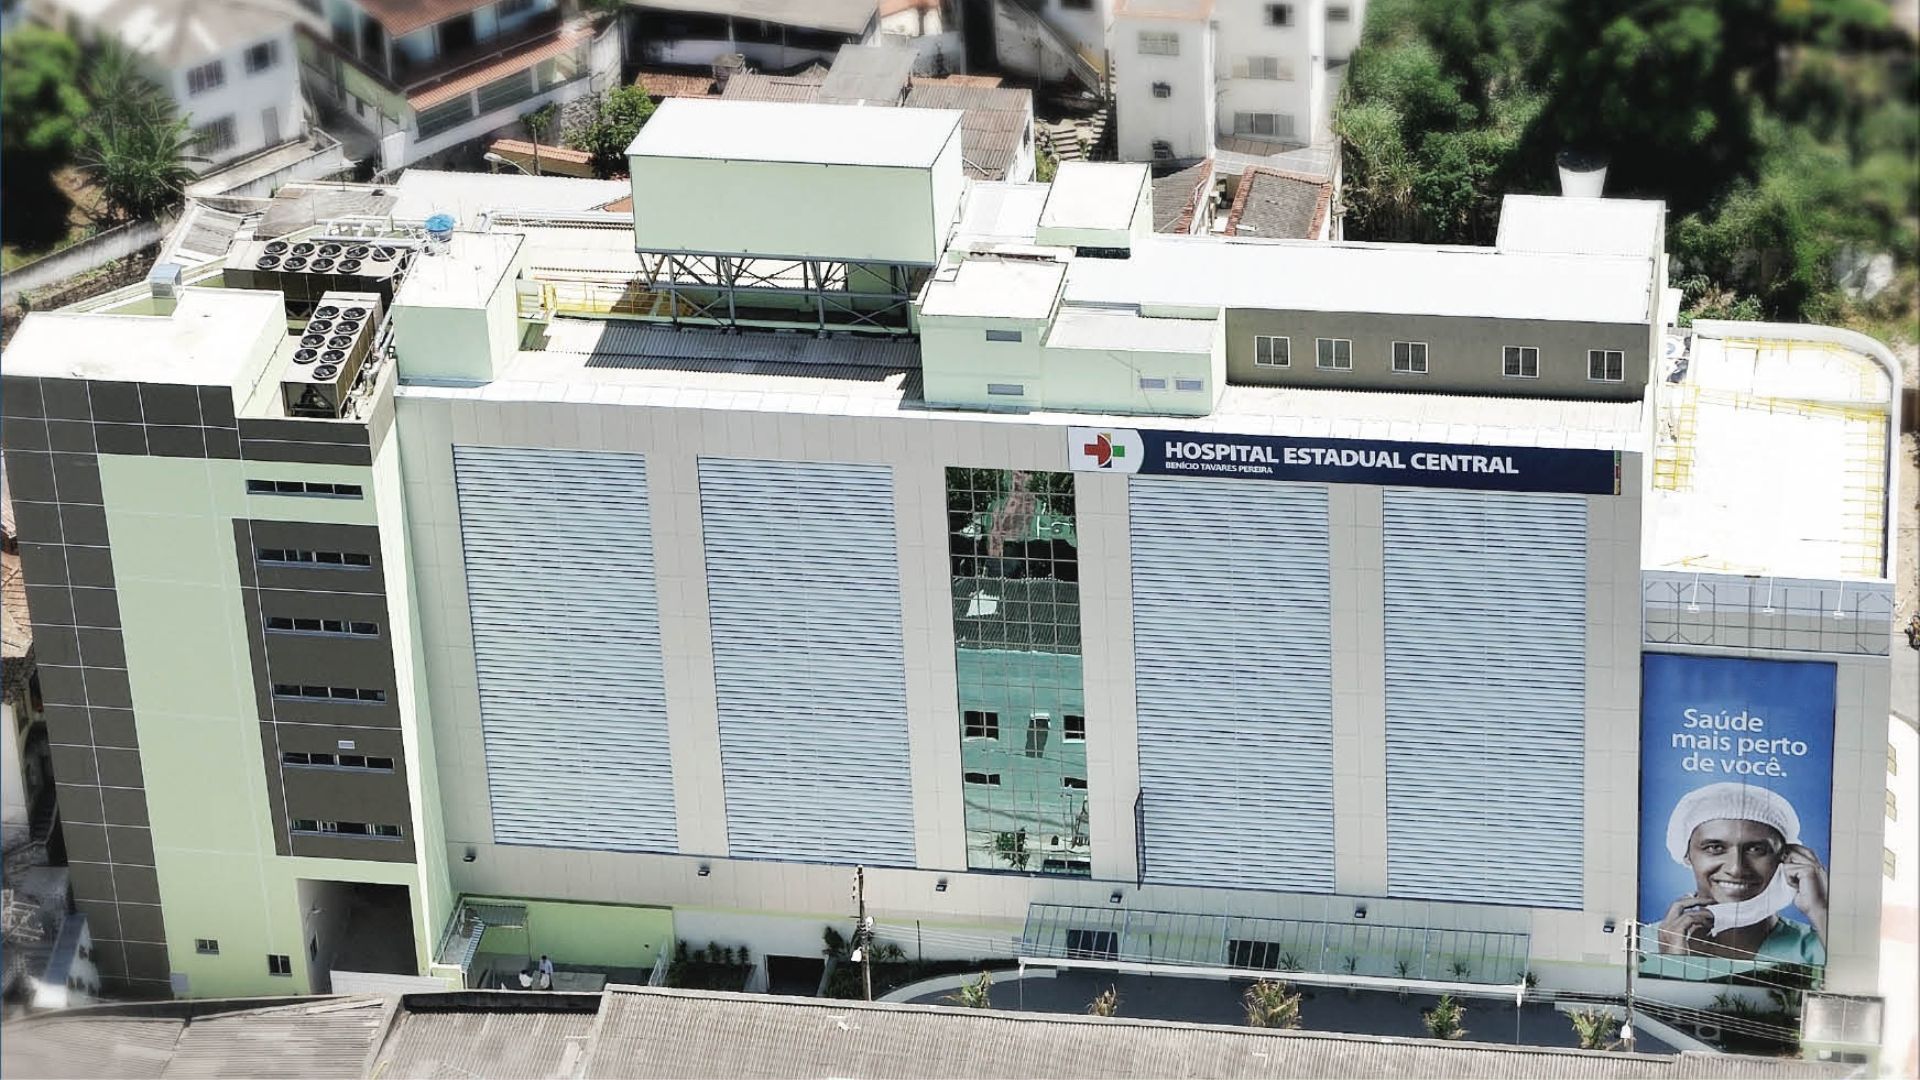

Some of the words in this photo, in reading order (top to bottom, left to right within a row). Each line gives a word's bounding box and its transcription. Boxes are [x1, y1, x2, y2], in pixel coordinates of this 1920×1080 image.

[1165, 441, 1280, 464] HOSPITAL
[1283, 447, 1407, 469] ESTADUAL
[1410, 452, 1520, 474] CENTRAL
[1165, 461, 1200, 470] BENÍCIO
[1201, 463, 1237, 472] TAVARES
[1238, 466, 1274, 474] PEREIRA
[1683, 708, 1764, 732] Saúde
[1671, 730, 1731, 751] mais
[1737, 737, 1808, 756] perto
[1681, 752, 1715, 772] de
[1720, 756, 1788, 777] você.
